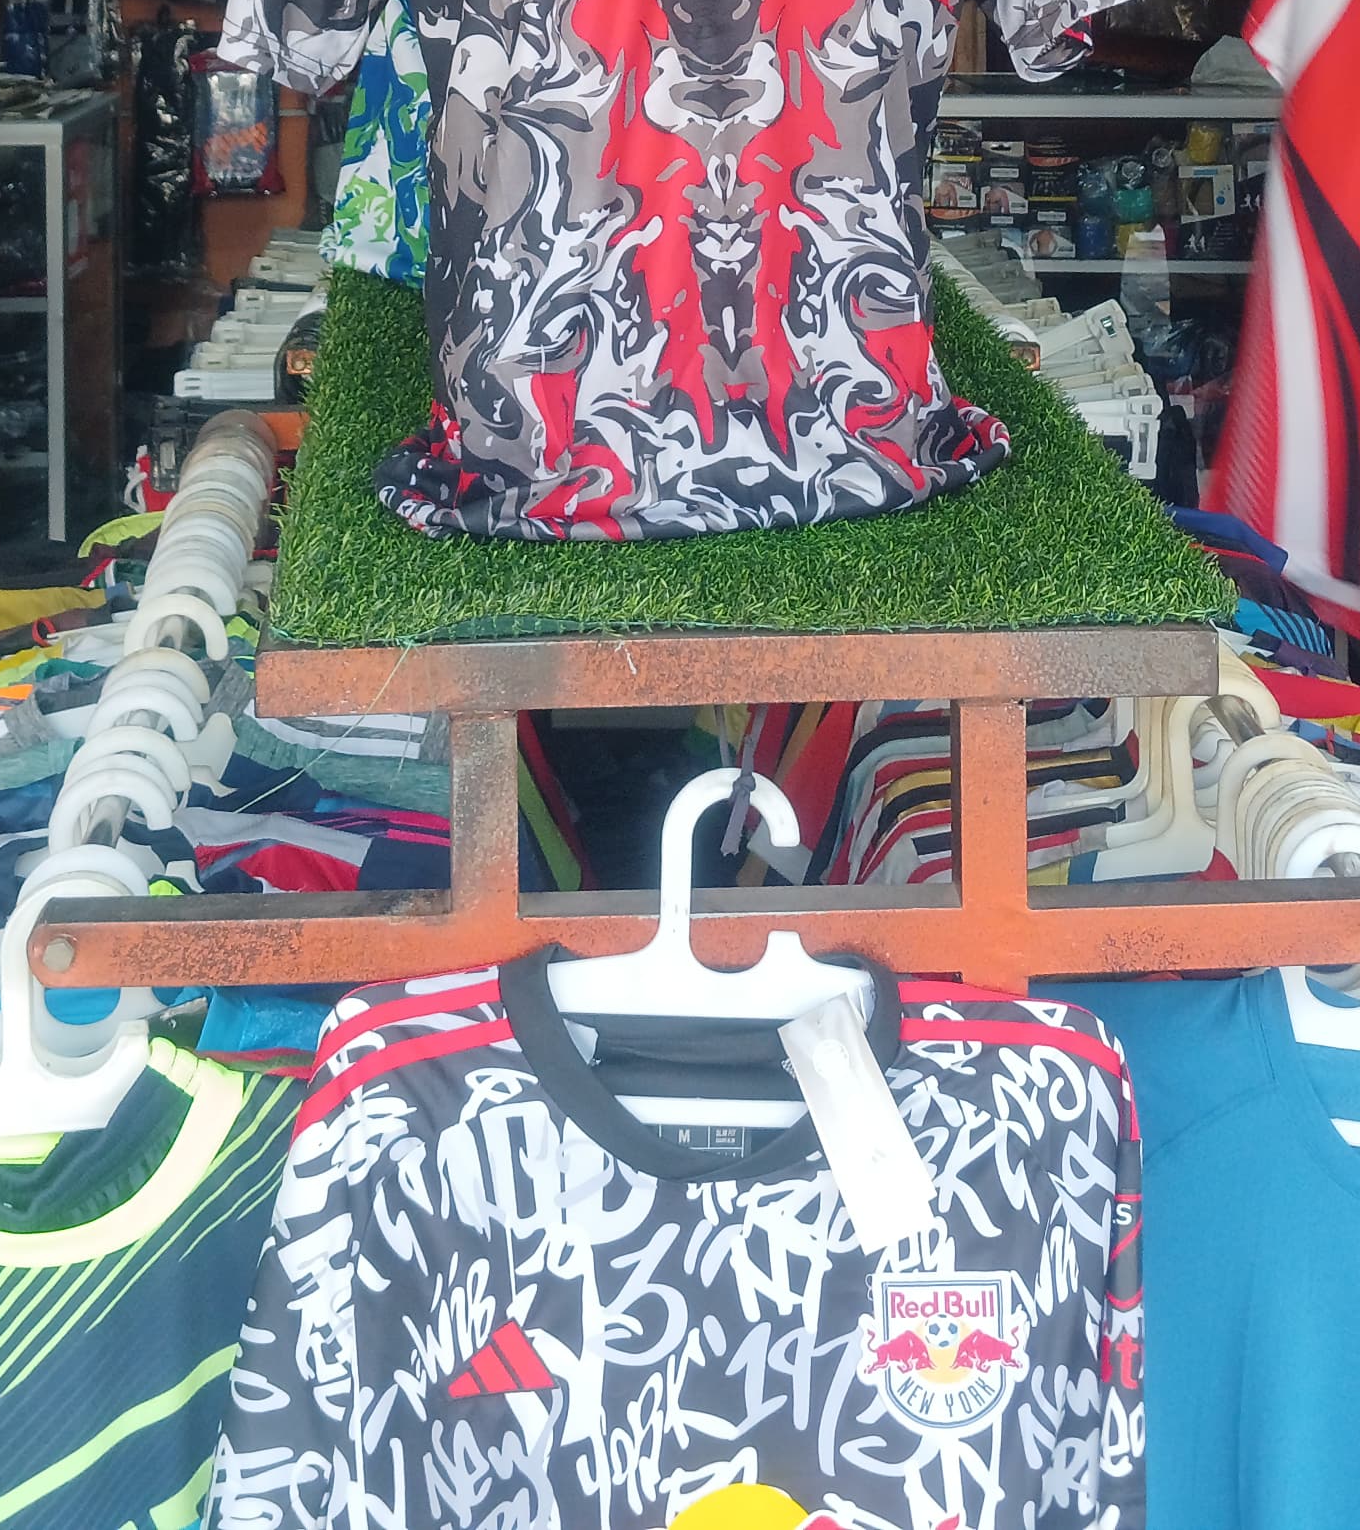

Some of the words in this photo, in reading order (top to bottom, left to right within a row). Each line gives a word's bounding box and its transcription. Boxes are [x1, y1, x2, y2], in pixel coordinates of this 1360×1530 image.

[678, 1128, 691, 1144] M
[889, 1290, 939, 1319] Red
[943, 1290, 995, 1318] Bull
[896, 1375, 936, 1415] NEW
[944, 1376, 996, 1418] YORK
